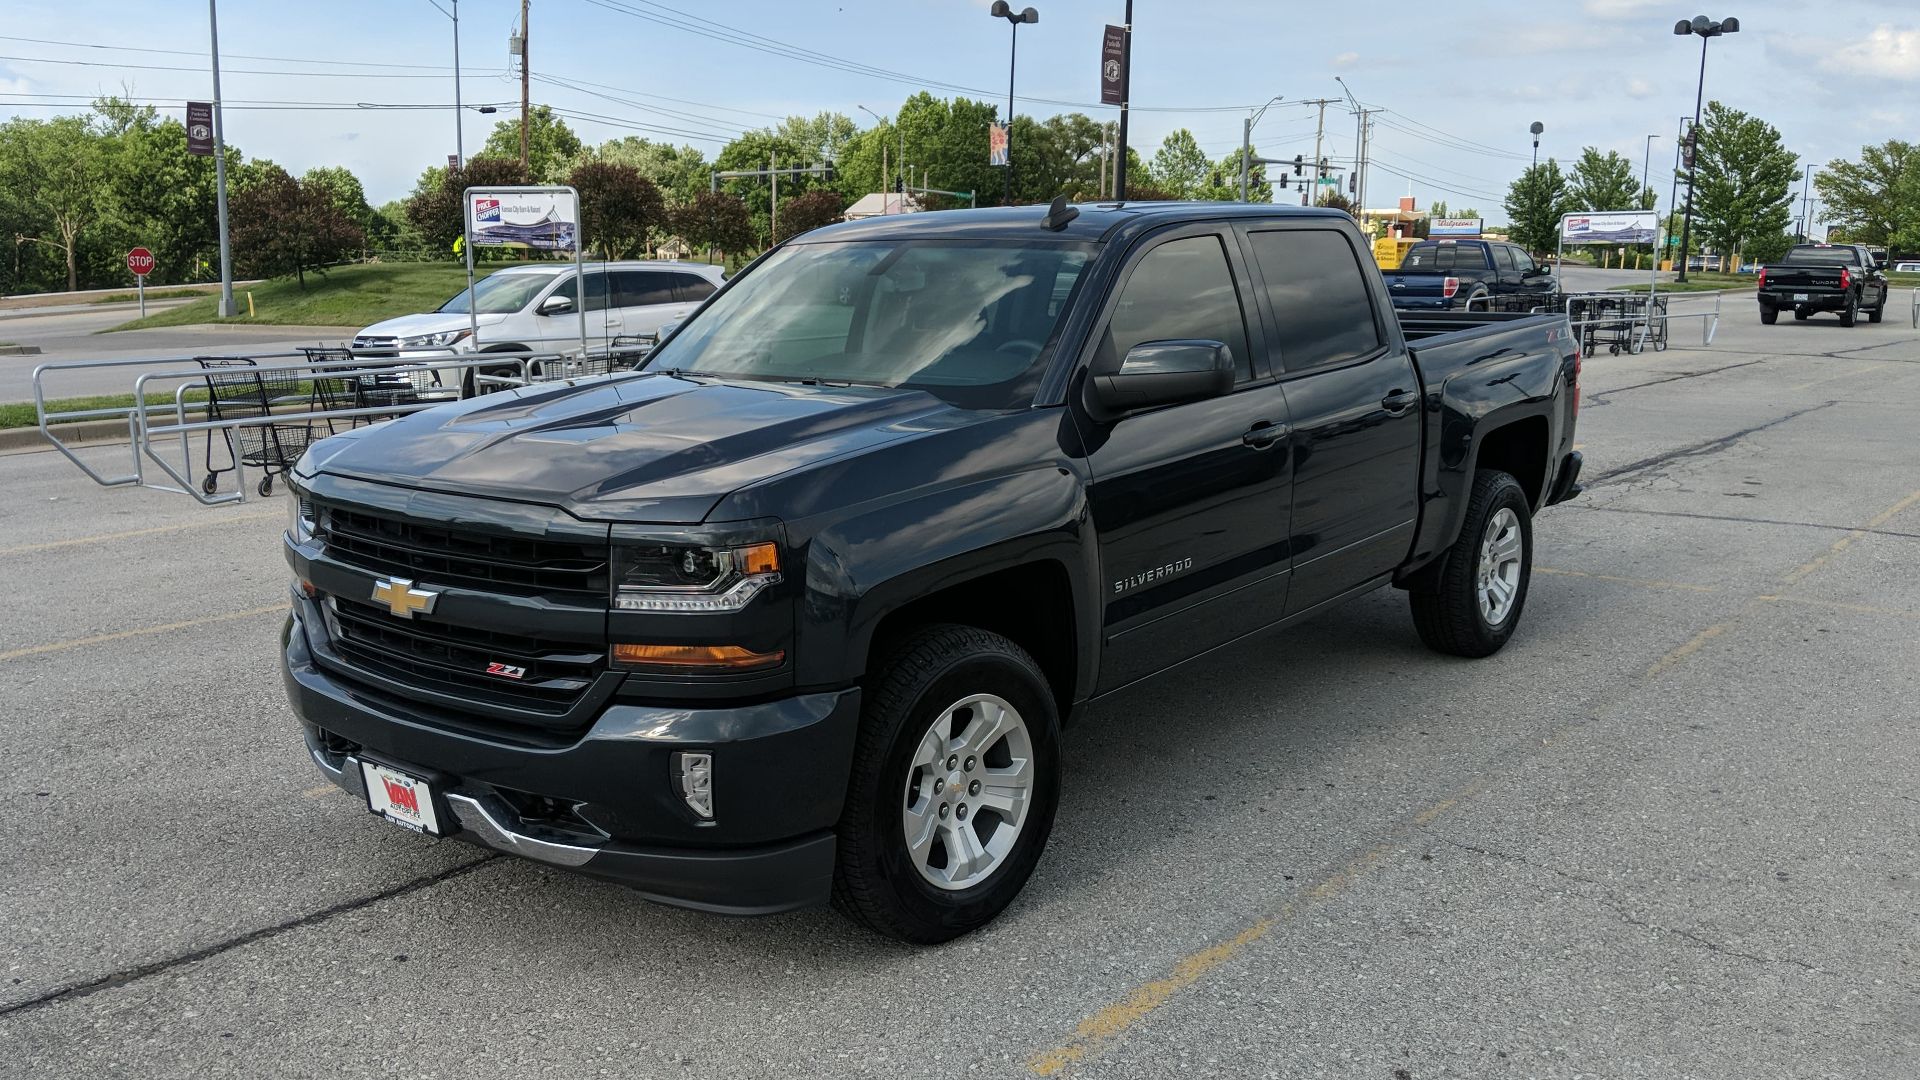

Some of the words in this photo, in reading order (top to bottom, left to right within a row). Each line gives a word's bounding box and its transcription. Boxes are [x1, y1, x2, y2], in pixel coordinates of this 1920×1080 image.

[477, 200, 491, 211] PRICE
[477, 208, 500, 220] CHOPPER
[129, 256, 152, 267] STOP
[1114, 557, 1192, 594] SILVERADO
[486, 662, 526, 679] Z71
[380, 774, 420, 813] VAN
